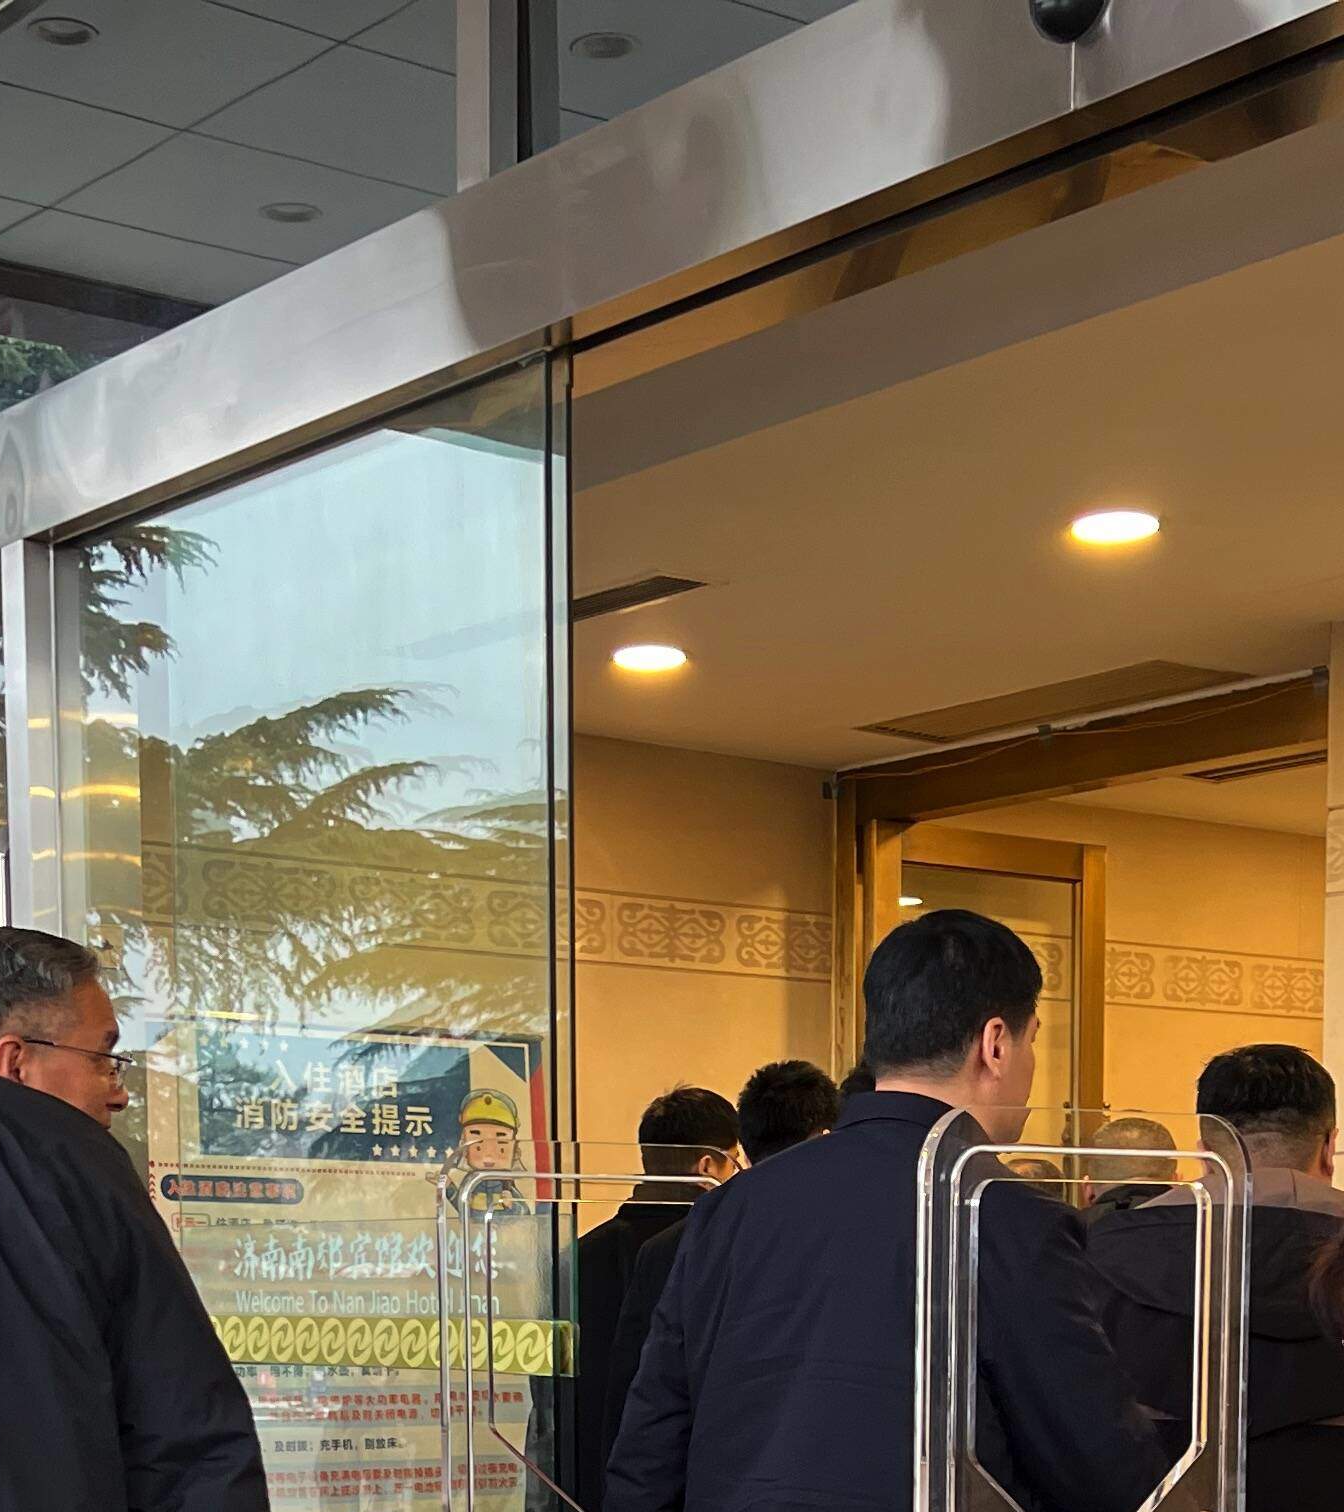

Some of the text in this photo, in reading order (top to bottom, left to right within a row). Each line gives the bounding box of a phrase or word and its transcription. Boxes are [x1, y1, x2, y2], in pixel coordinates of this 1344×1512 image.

[270, 1059, 399, 1099] 入住酒店
[232, 1097, 434, 1137] 消防安全提示
[235, 1289, 305, 1314] Welcome
[308, 1289, 328, 1314] To
[333, 1289, 365, 1314] Nan
[369, 1289, 401, 1314] Jiao
[407, 1289, 454, 1314] Hotl
